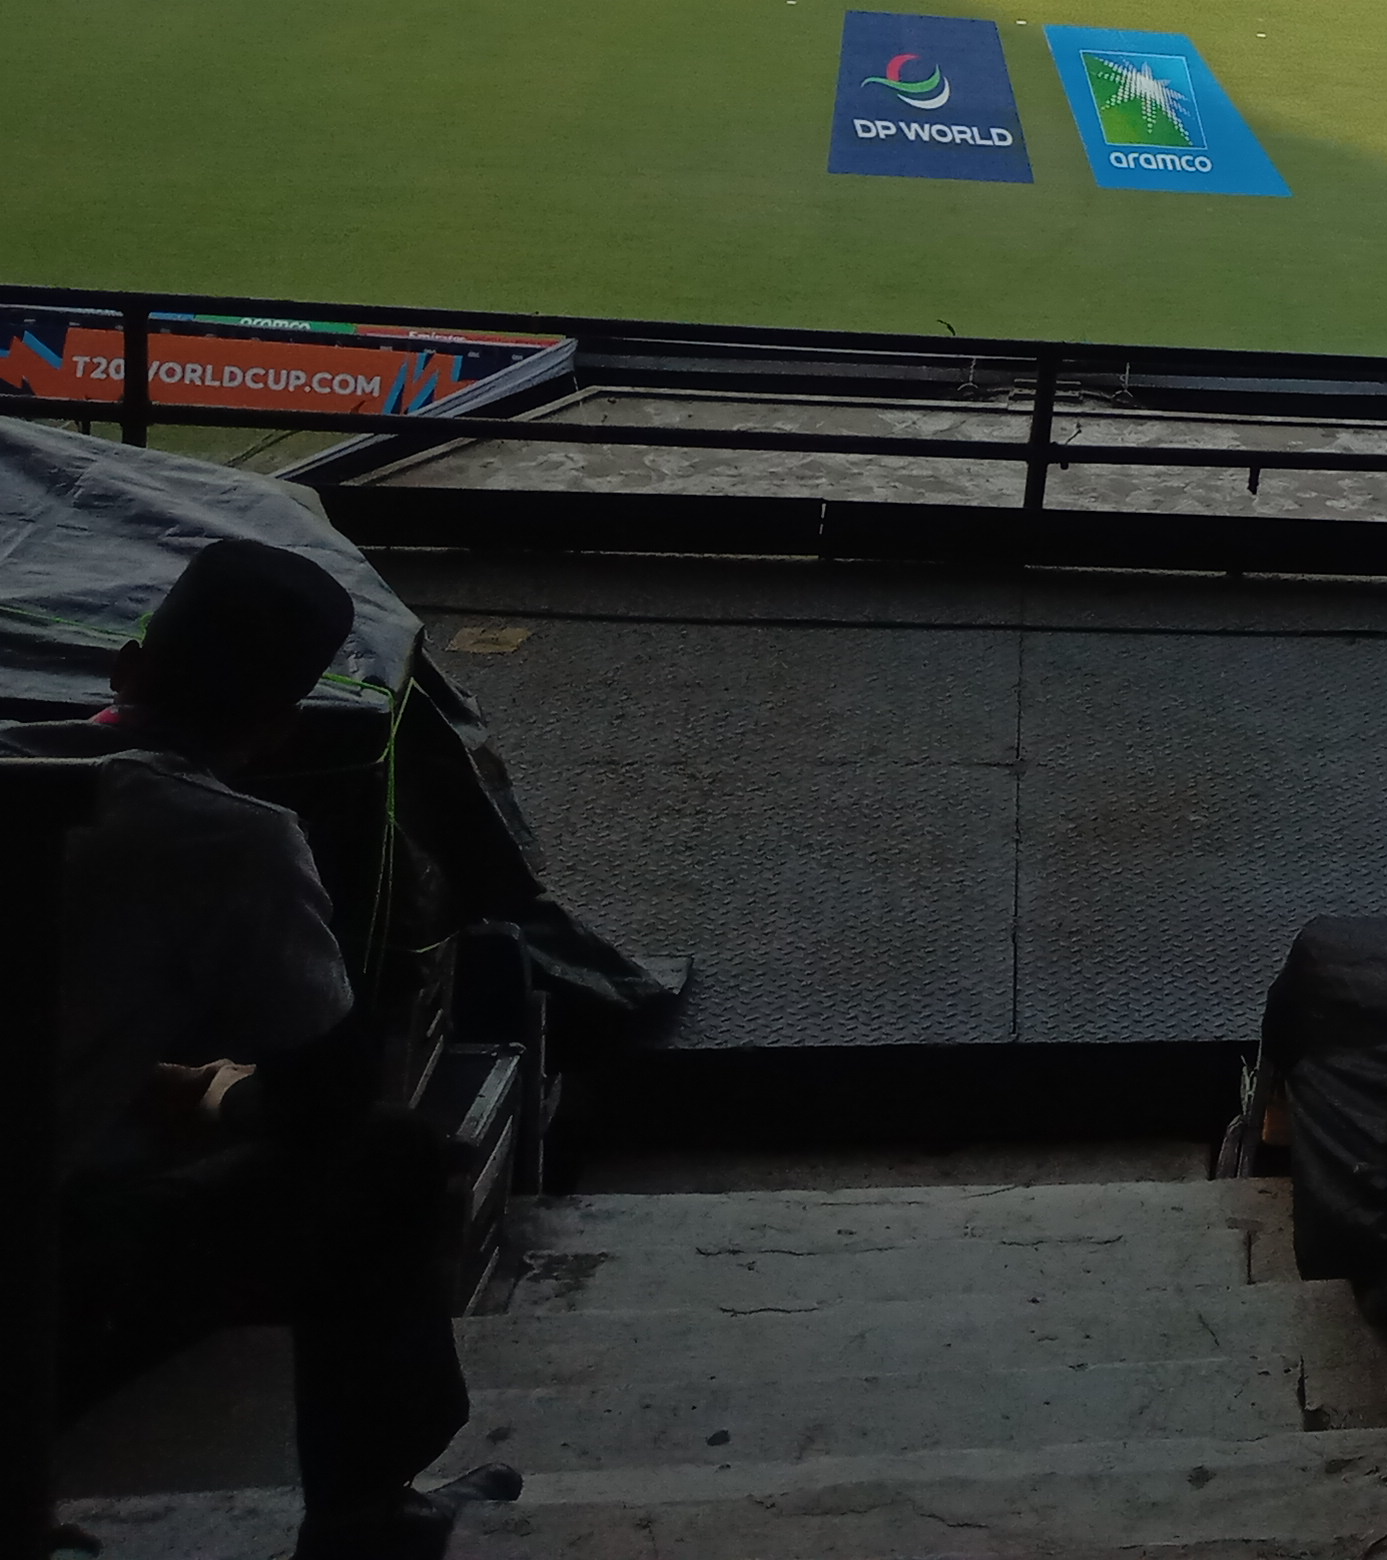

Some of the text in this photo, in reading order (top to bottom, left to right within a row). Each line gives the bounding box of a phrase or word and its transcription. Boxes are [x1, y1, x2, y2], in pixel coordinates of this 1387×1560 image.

[853, 119, 1013, 147] DP WORLD
[1110, 152, 1212, 173] aramco
[71, 354, 381, 397] T20ORLDCUP.COM
